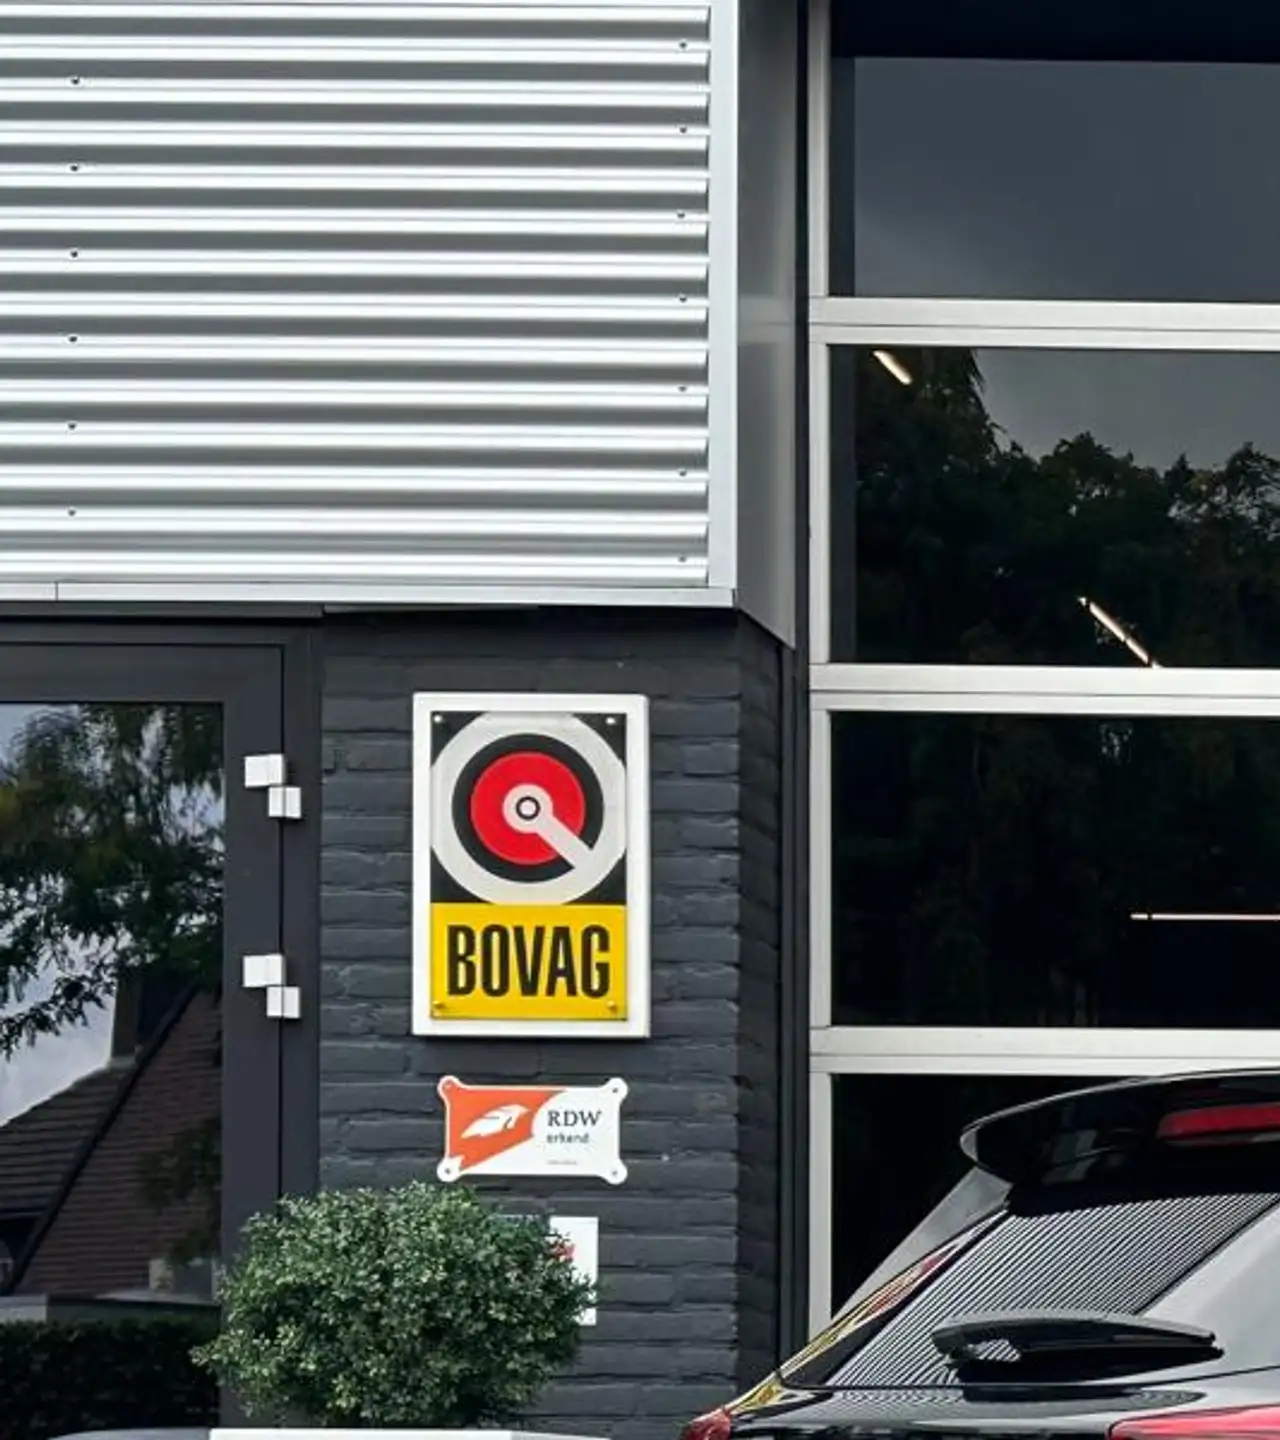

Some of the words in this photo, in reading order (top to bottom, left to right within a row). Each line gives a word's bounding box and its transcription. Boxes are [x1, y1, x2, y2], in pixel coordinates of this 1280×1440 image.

[446, 924, 611, 998] BOVAG
[547, 1109, 602, 1127] RDW
[546, 1132, 590, 1145] erkend
